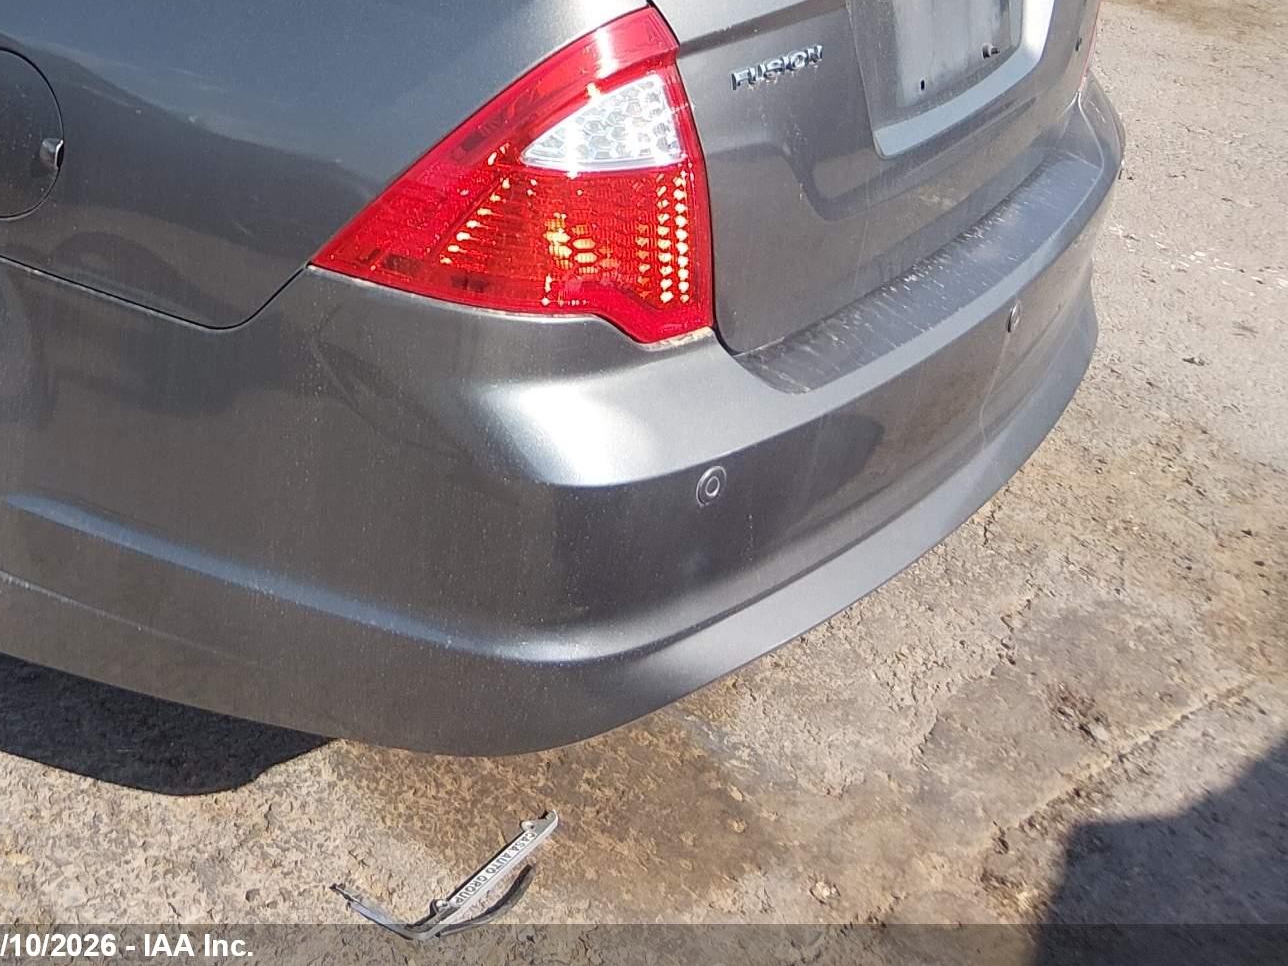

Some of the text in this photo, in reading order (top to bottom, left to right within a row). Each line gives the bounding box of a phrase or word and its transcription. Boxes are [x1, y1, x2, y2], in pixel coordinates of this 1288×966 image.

[730, 44, 823, 91] FUSION
[455, 832, 537, 904] CASA AUTO GROUP
